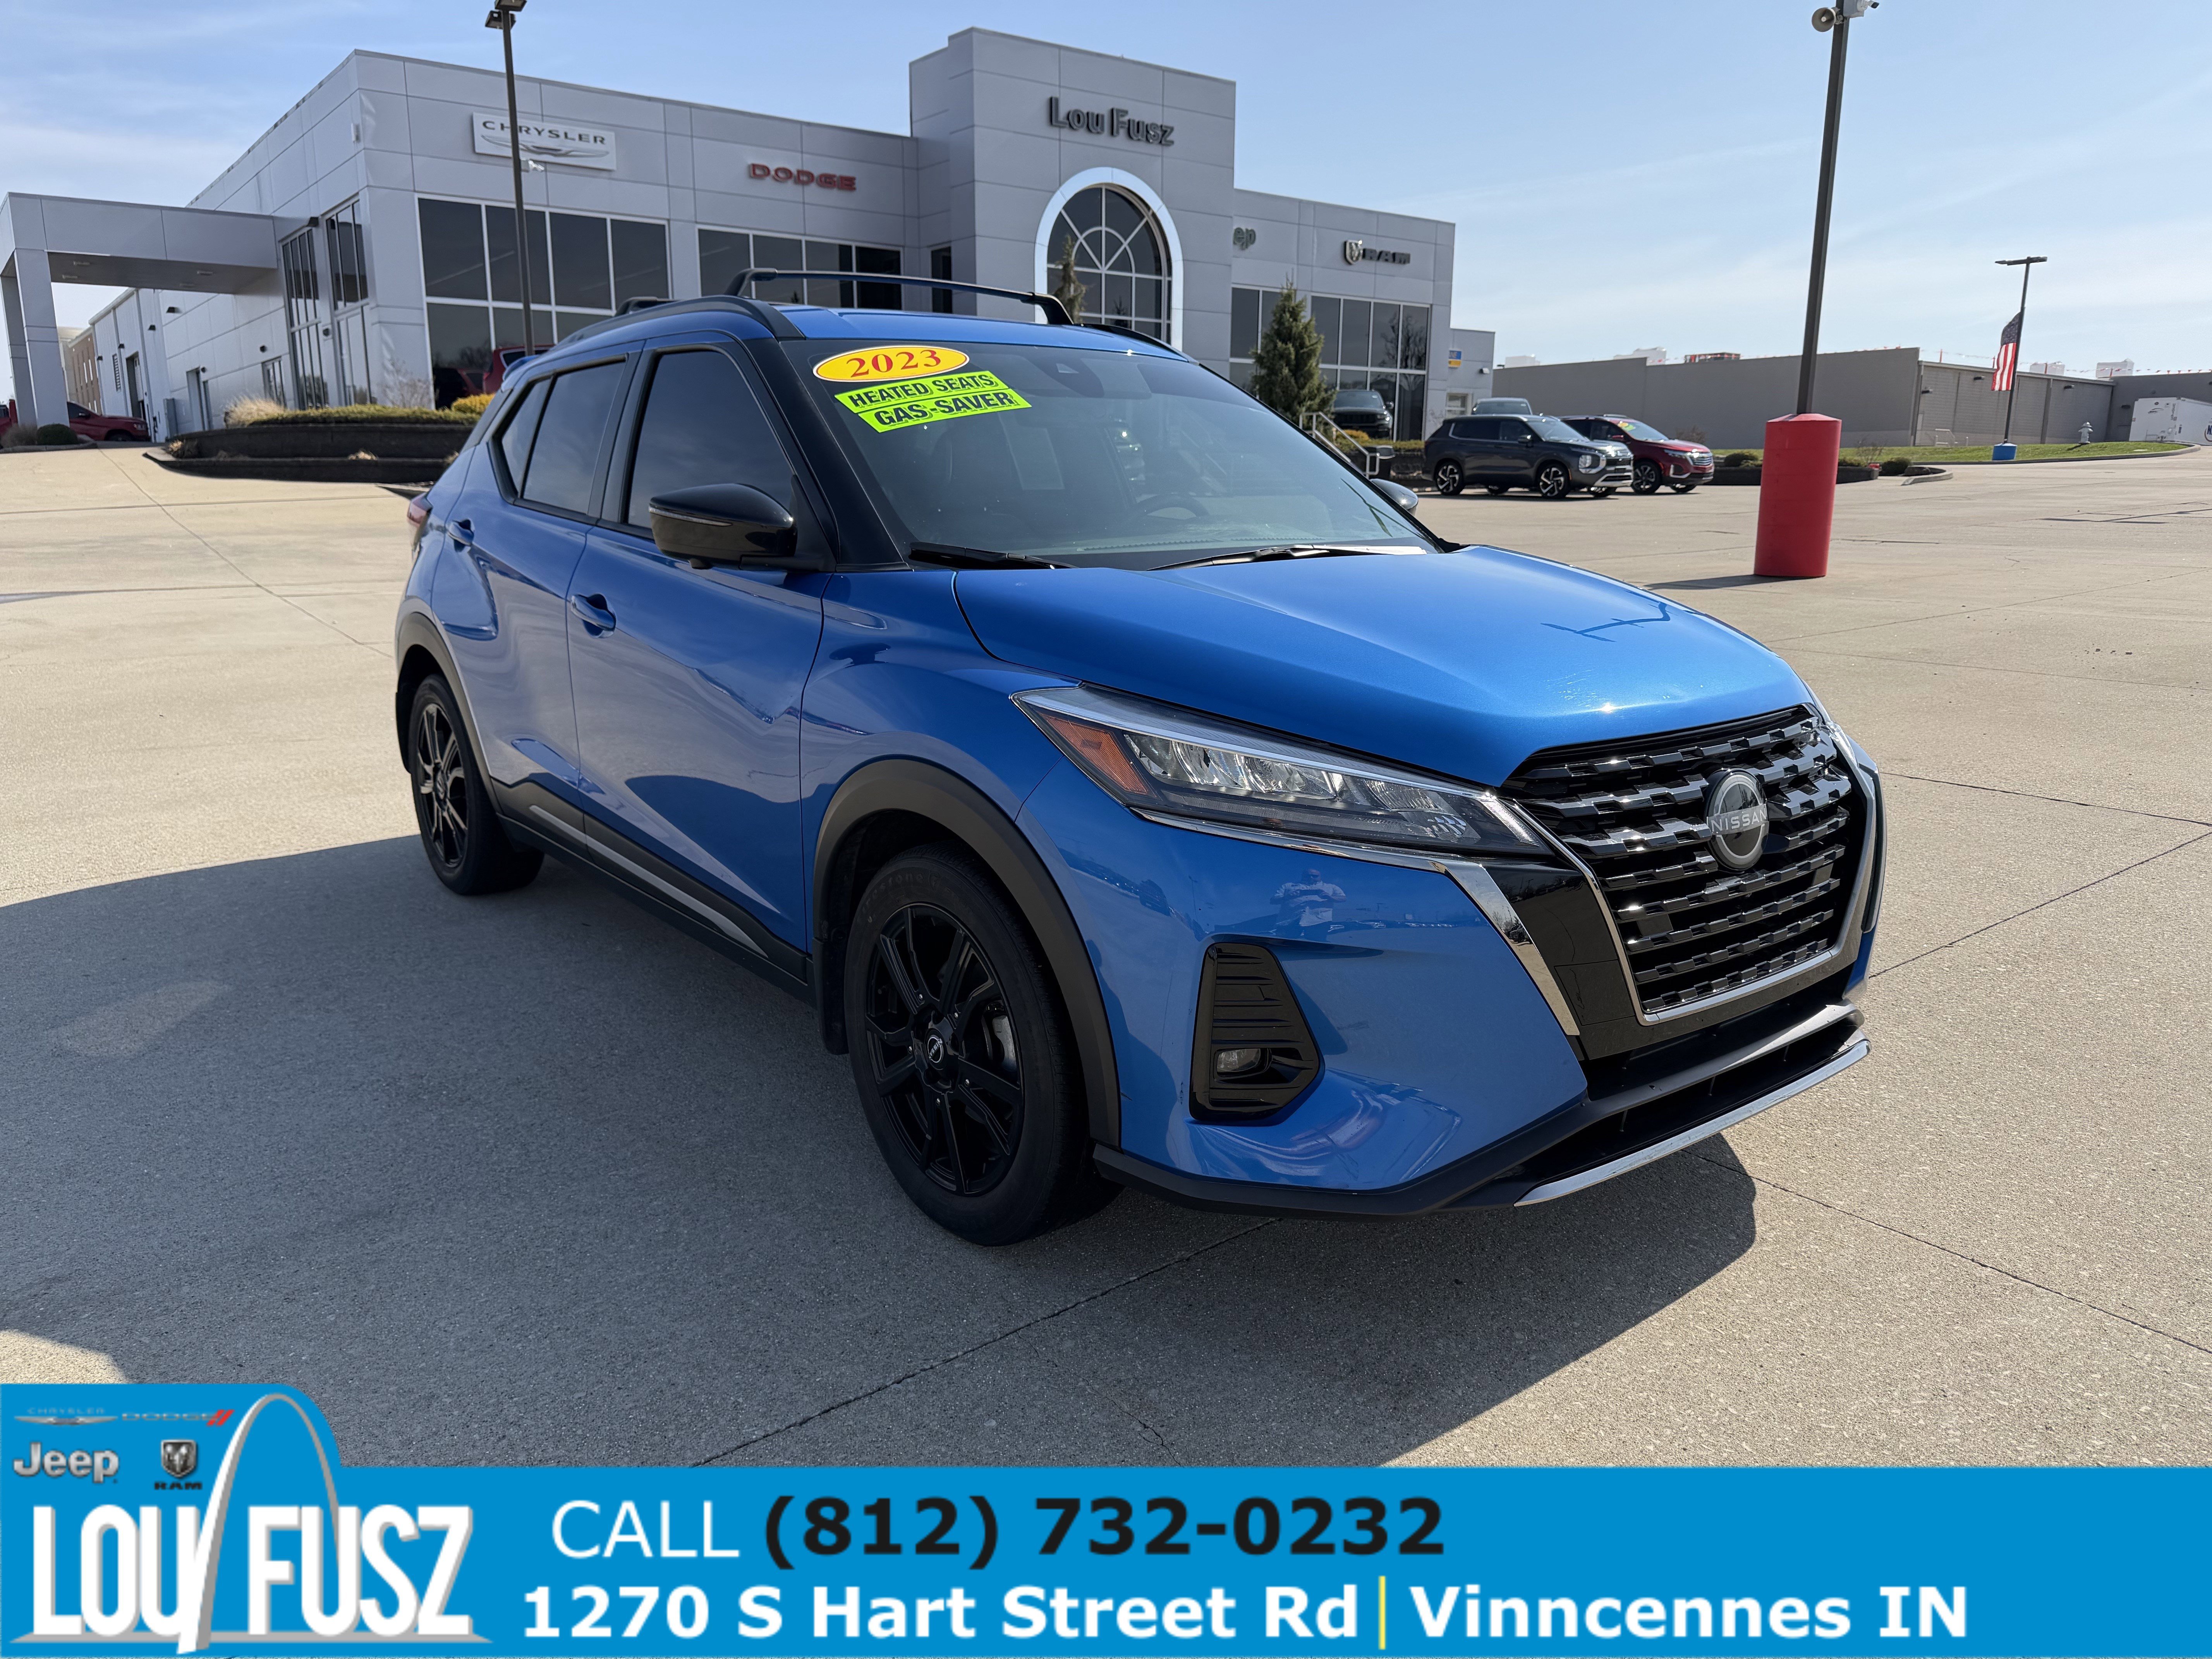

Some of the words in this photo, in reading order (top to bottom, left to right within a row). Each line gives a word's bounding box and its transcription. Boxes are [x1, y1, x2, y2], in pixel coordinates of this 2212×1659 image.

[482, 120, 606, 145] CHRYSLER
[1049, 96, 1105, 134] Lou
[1110, 107, 1175, 147] Fusz
[748, 163, 857, 191] DODGE
[1362, 248, 1411, 264] RAM
[846, 349, 941, 378] 2023
[848, 382, 933, 408] HEATED
[932, 373, 999, 393] SEATS
[874, 392, 1019, 426] GAS-SAVER
[1711, 809, 1767, 832] NISSAN
